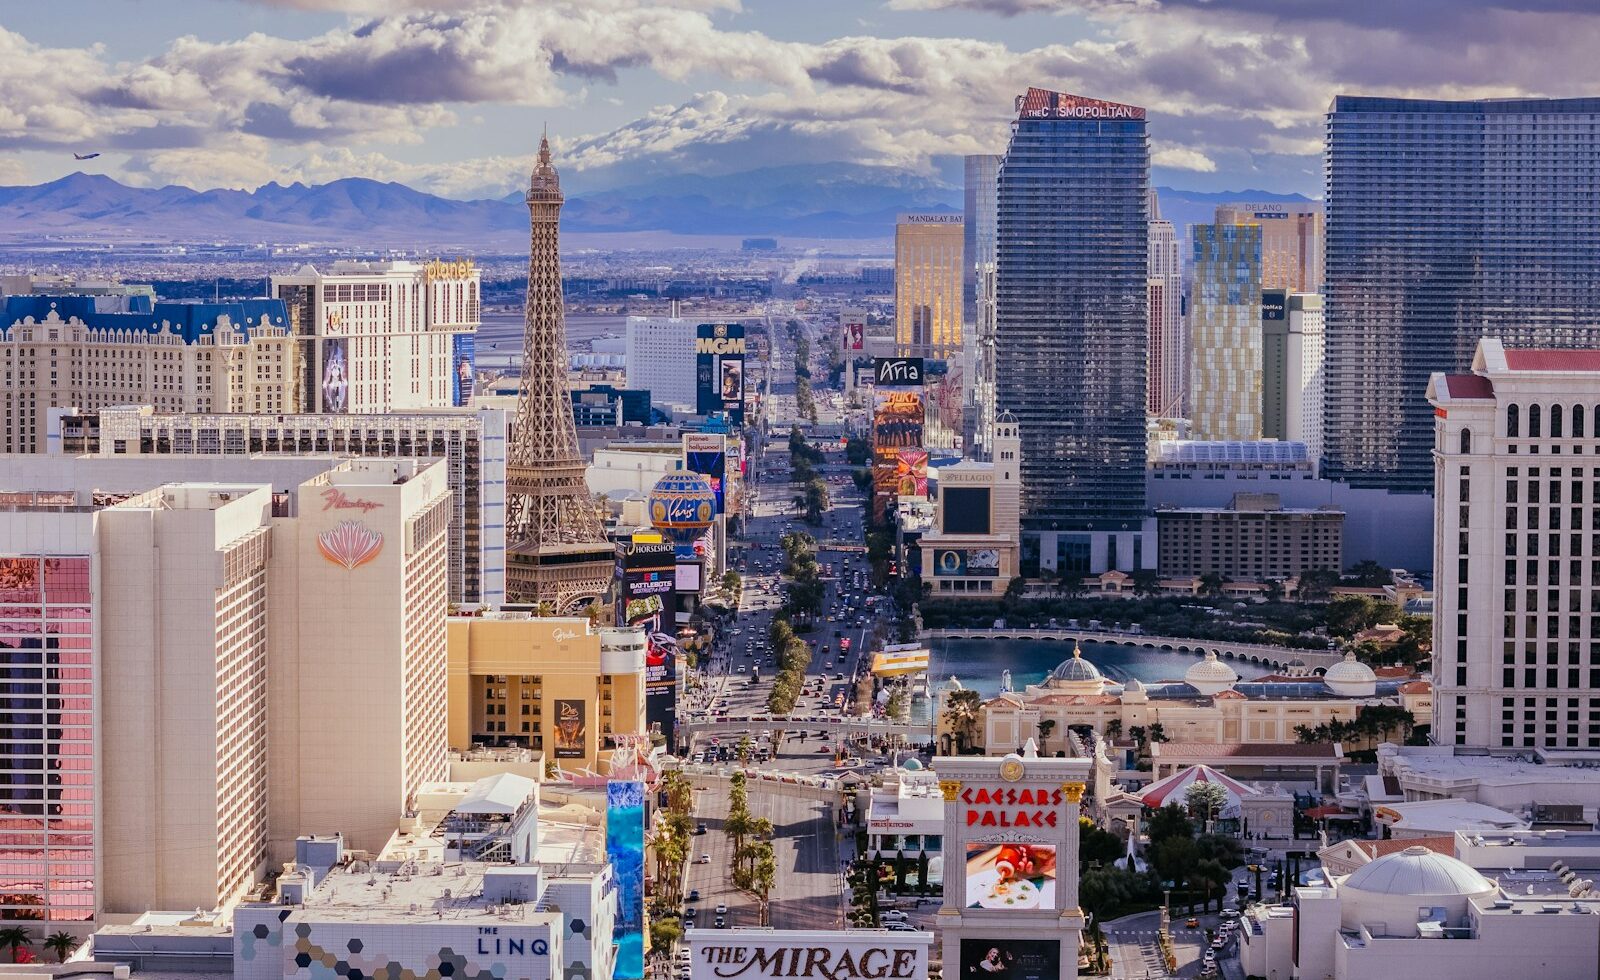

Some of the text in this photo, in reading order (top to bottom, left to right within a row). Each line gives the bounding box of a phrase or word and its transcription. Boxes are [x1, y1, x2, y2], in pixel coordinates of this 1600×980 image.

[1028, 106, 1132, 118] THE CSMOPOLITAN
[1245, 203, 1282, 212] DELANO
[908, 215, 963, 223] MANDALAY BAY
[427, 257, 474, 285] planet
[695, 337, 746, 354] MGM
[879, 360, 918, 381] Aria
[944, 473, 993, 482] BELLAGIO
[668, 495, 696, 526] Paris
[635, 544, 675, 554] HORSESHOE
[940, 550, 961, 571] O
[630, 580, 673, 590] BATTLEBOTS
[961, 787, 1063, 806] CAESARS
[967, 810, 1057, 828] PALACE
[478, 927, 498, 935] THE
[478, 938, 548, 956] LINQ
[701, 946, 917, 980] THE MIRAGE
